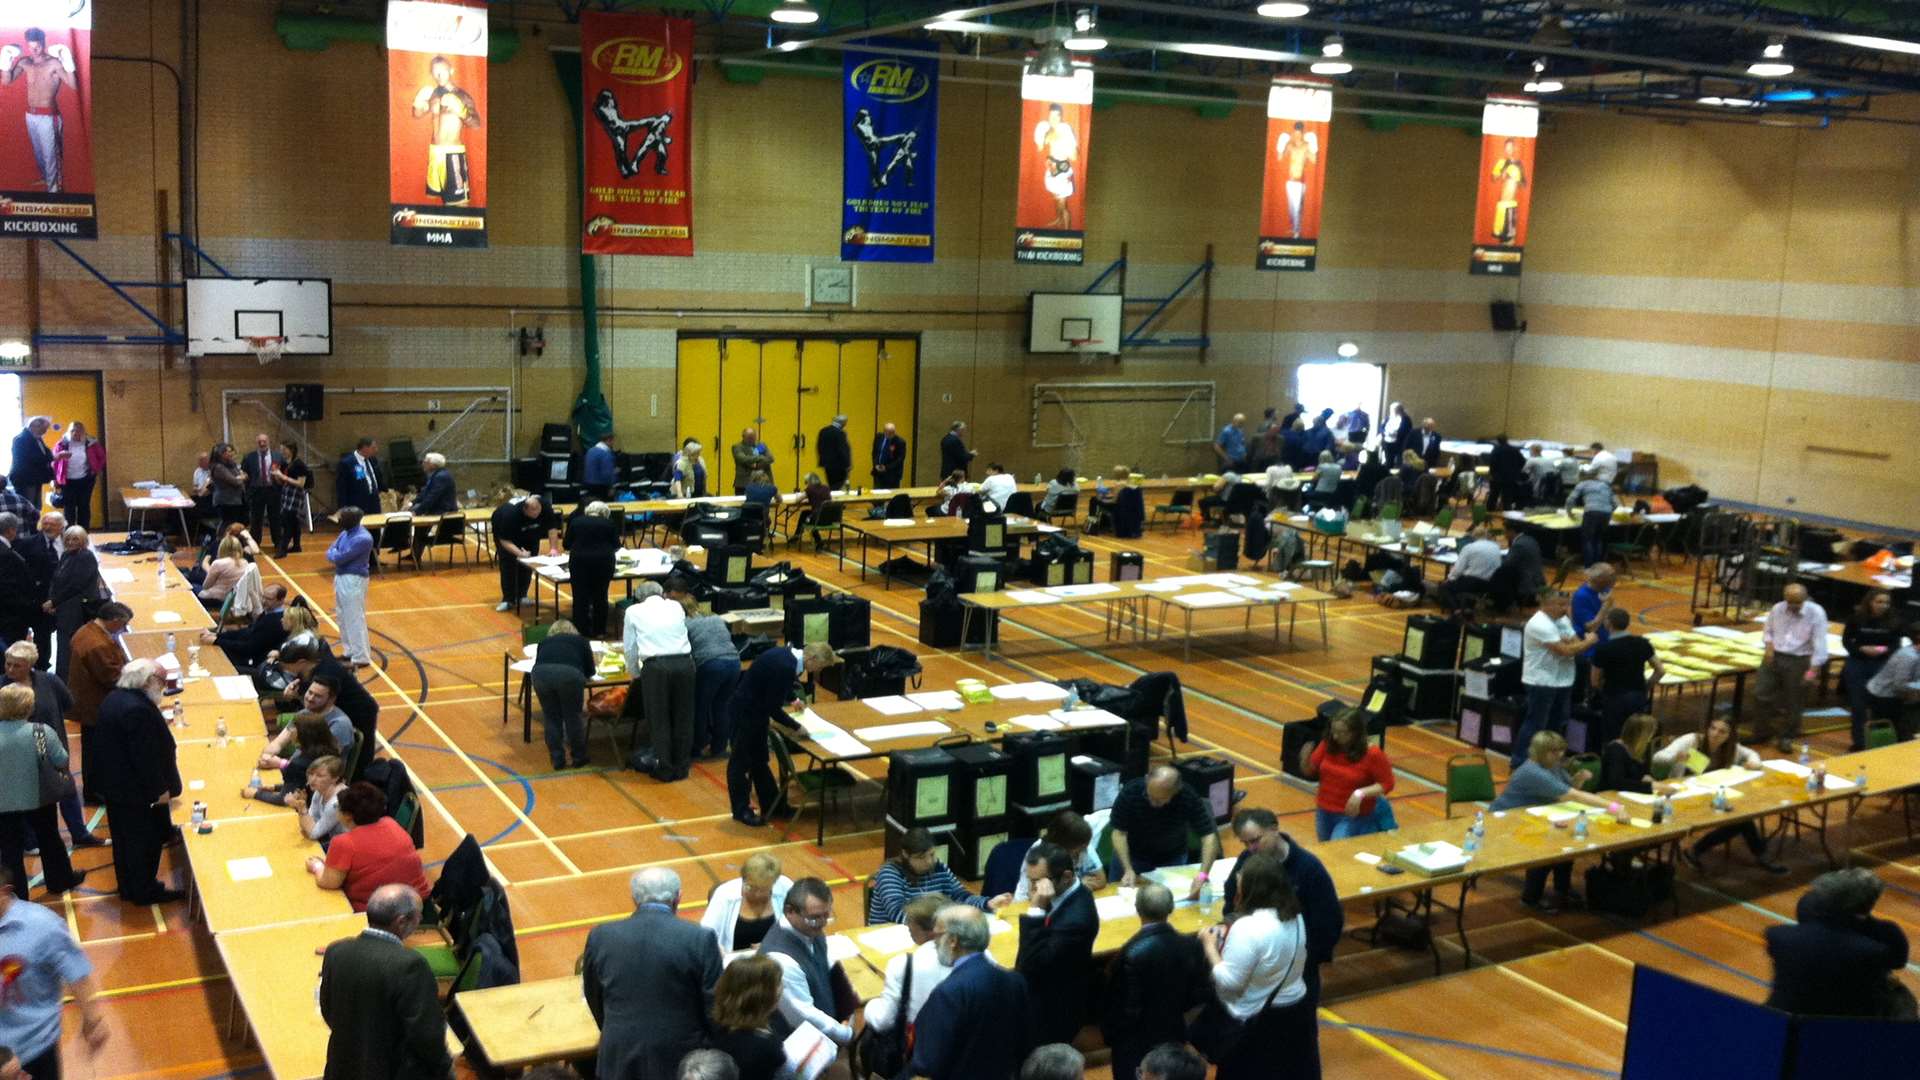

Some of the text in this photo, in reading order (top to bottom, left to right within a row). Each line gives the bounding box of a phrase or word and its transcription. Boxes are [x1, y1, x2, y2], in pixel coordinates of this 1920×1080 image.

[613, 44, 664, 67] RM
[872, 65, 913, 88] RM
[4, 221, 78, 233] KICKBOXING
[426, 232, 453, 243] MMA
